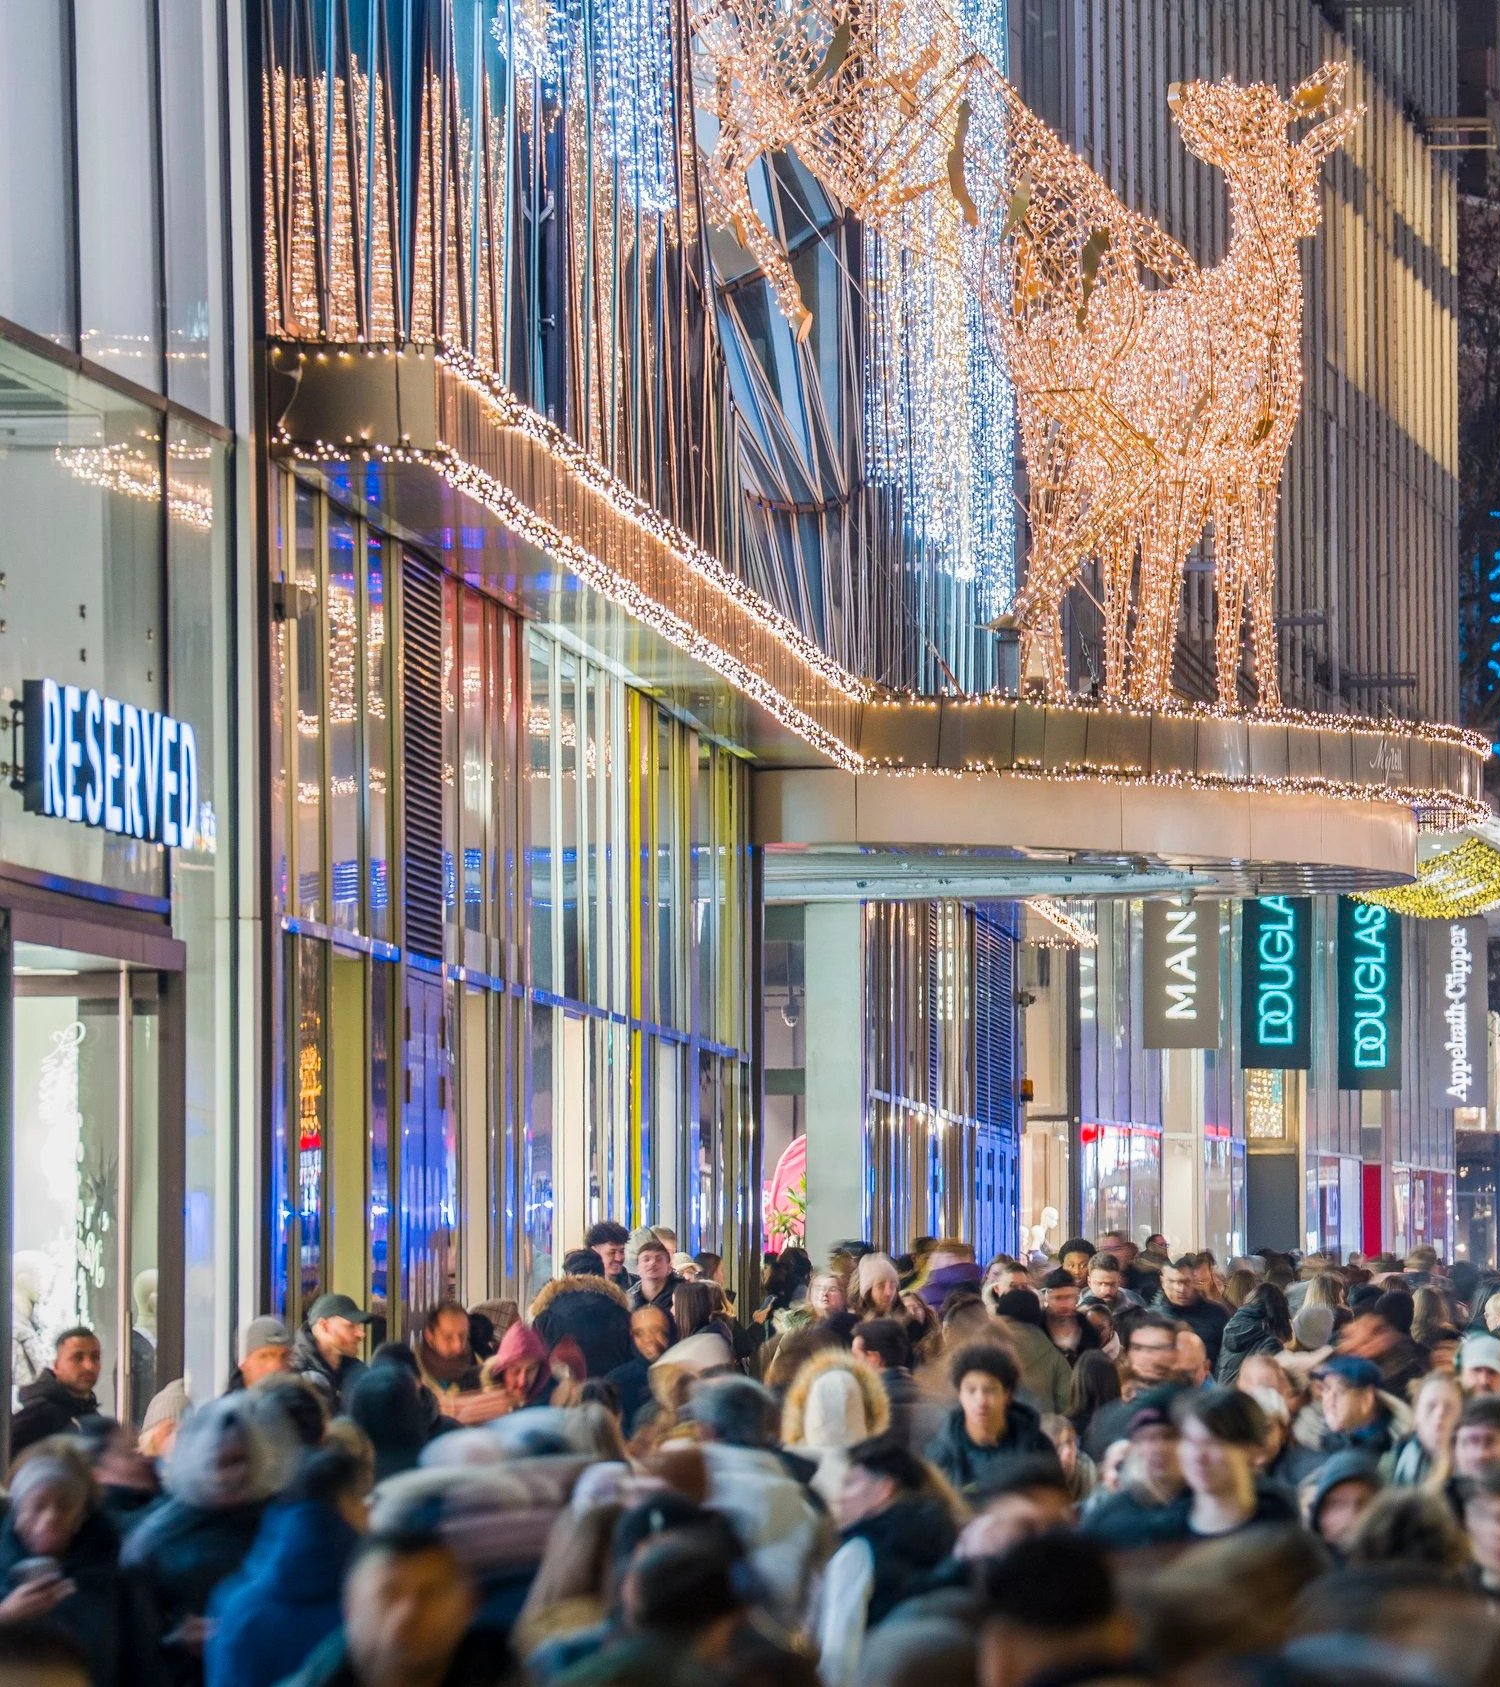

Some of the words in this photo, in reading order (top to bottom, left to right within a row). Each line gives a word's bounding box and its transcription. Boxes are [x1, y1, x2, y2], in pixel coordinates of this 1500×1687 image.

[43, 678, 198, 849] RESERVED
[1165, 898, 1197, 1020] MAN
[1354, 904, 1387, 1068] DOUGLAS
